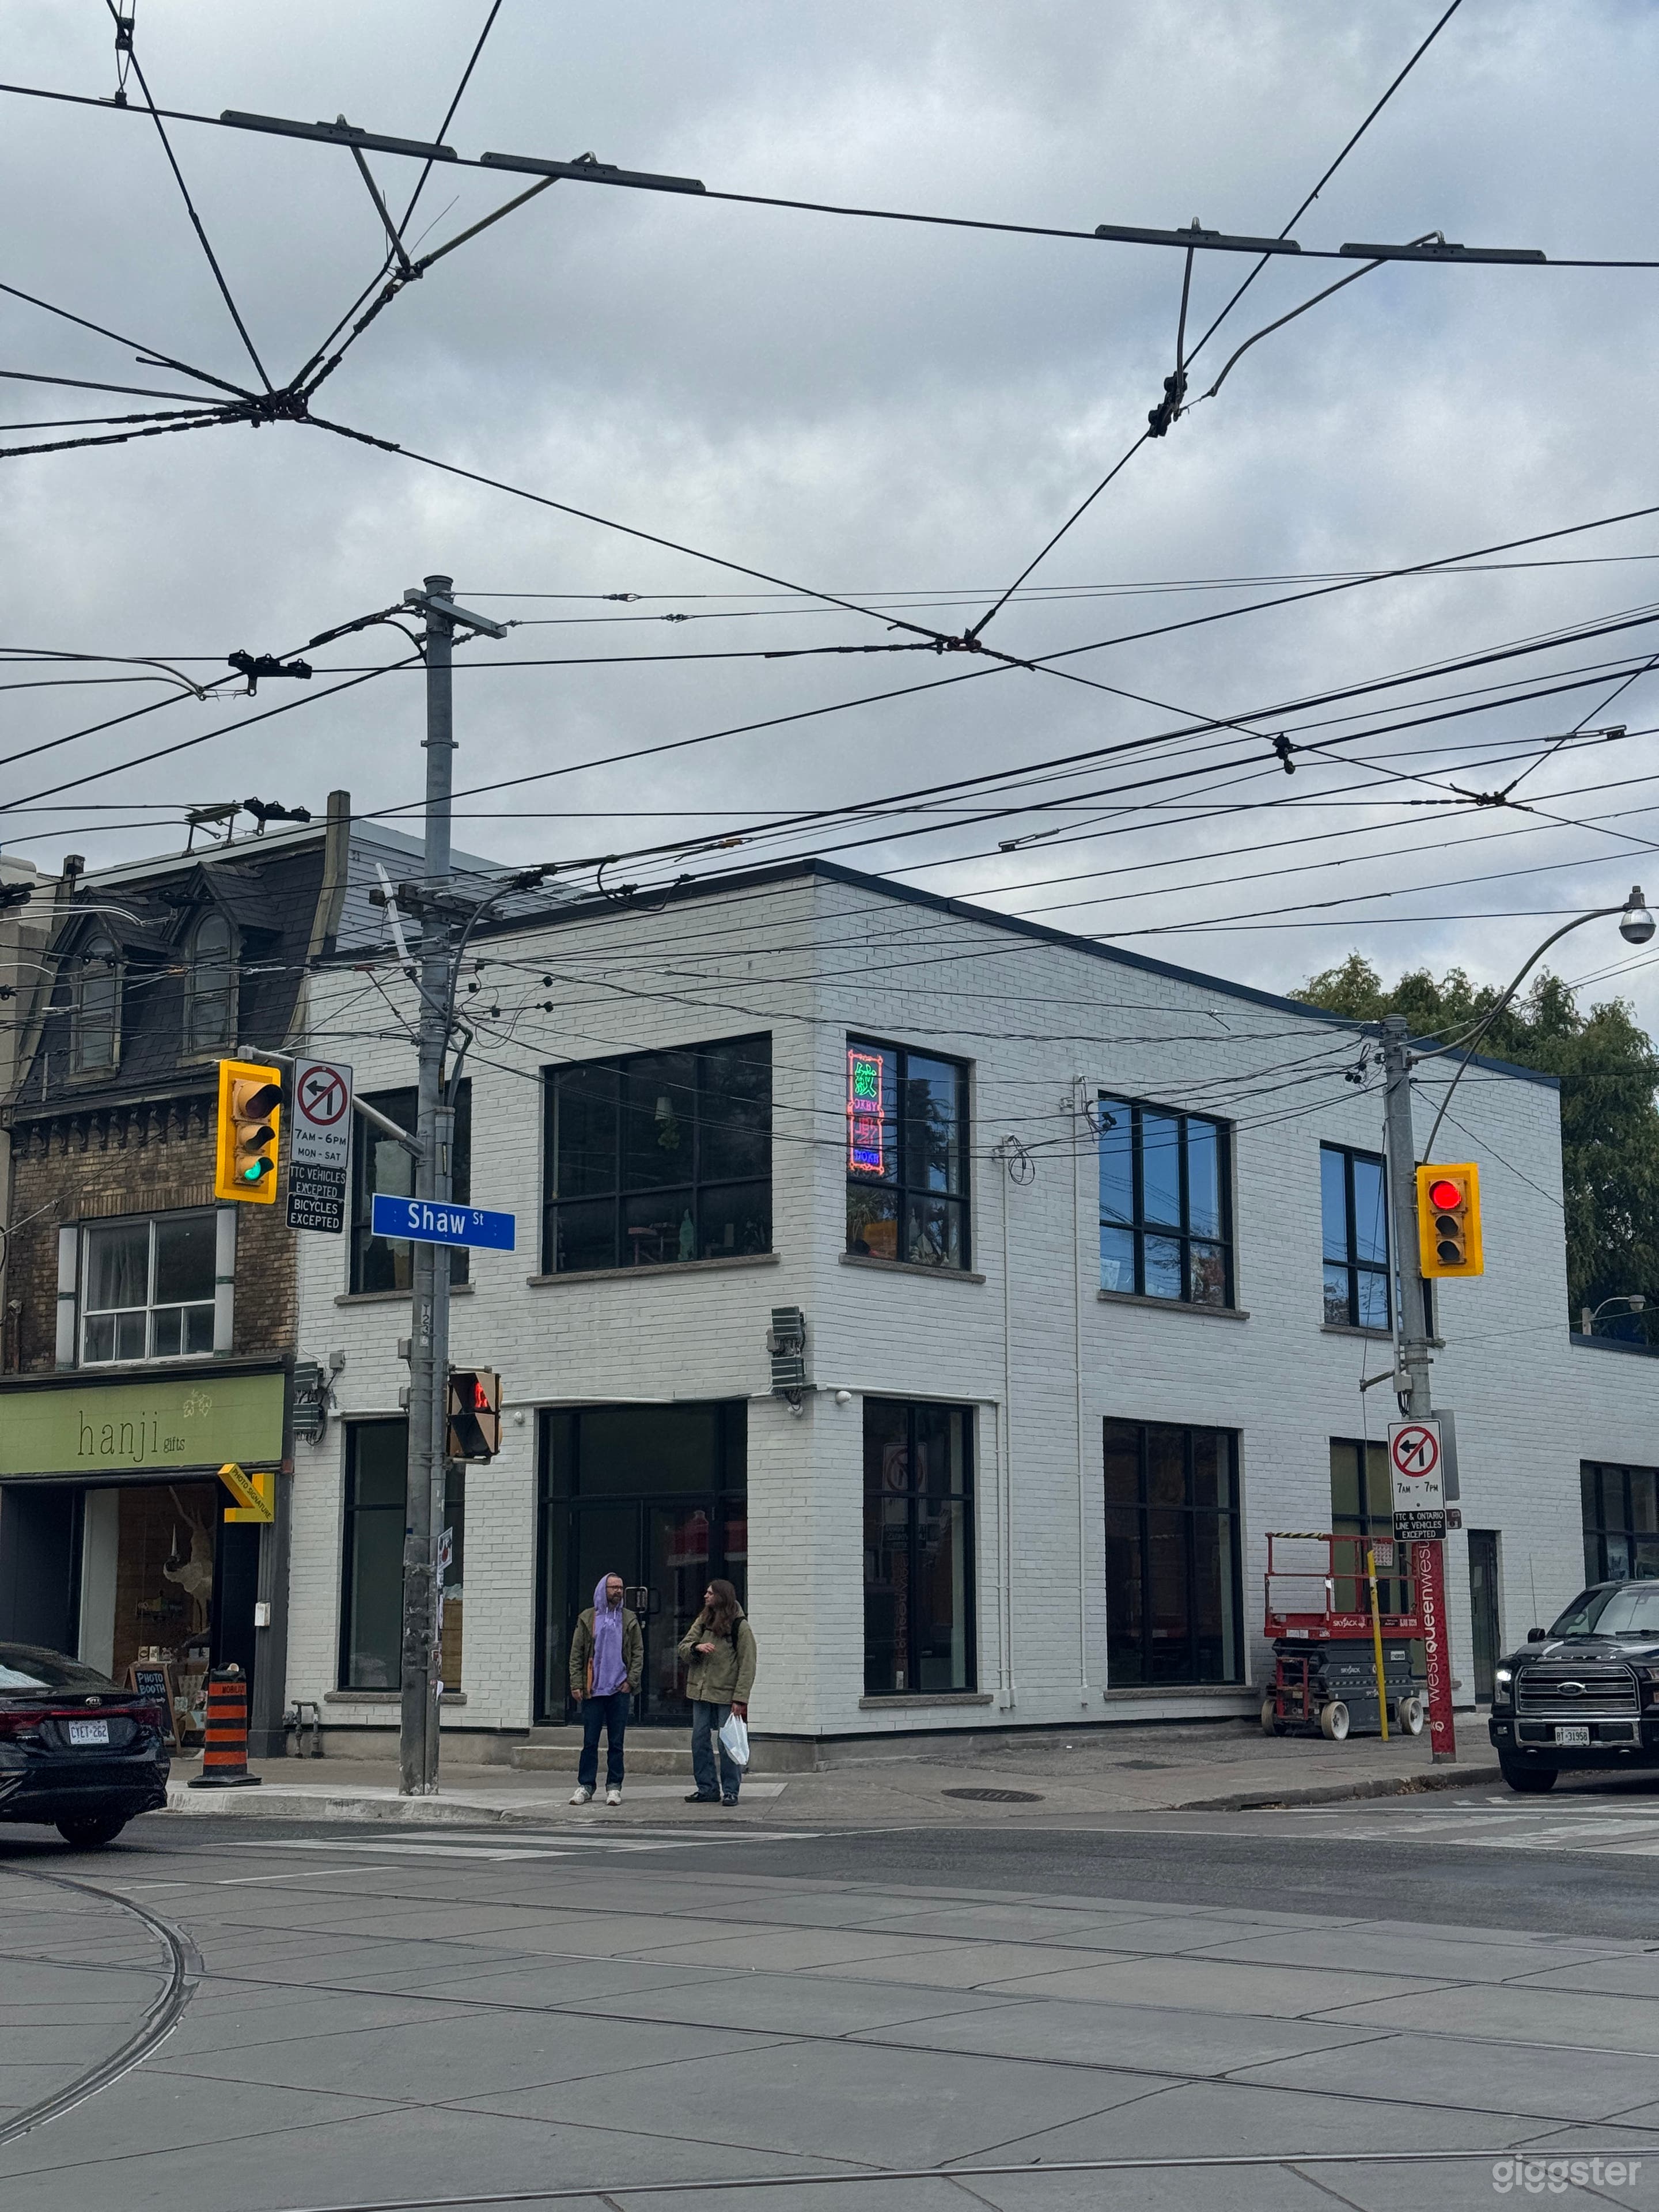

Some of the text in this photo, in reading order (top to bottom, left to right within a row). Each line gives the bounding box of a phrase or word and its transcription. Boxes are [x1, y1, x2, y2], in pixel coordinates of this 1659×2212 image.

[295, 1128, 316, 1141] 7AM
[325, 1134, 346, 1145] 6PM
[298, 1147, 316, 1157] MON
[324, 1152, 341, 1161] SAT
[290, 1165, 346, 1184] TTC VEHICLES
[296, 1181, 338, 1198] EXCEPTED
[294, 1199, 338, 1214] BICYCLES
[290, 1213, 339, 1229] EXCEPTED
[408, 1202, 484, 1234] Shaw St
[77, 1410, 185, 1463] hanji gifts
[232, 1468, 272, 1520] PHOTO SIGNATURE
[1397, 1482, 1411, 1493] 7AM
[1424, 1481, 1439, 1493] 7PM
[1395, 1511, 1444, 1521] TTC & ONTARIO
[1411, 1521, 1442, 1530] VEHICLES
[1402, 1529, 1436, 1539] EXCEPTED
[136, 1672, 164, 1684] PHOTO
[139, 1683, 166, 1695] BOOTH
